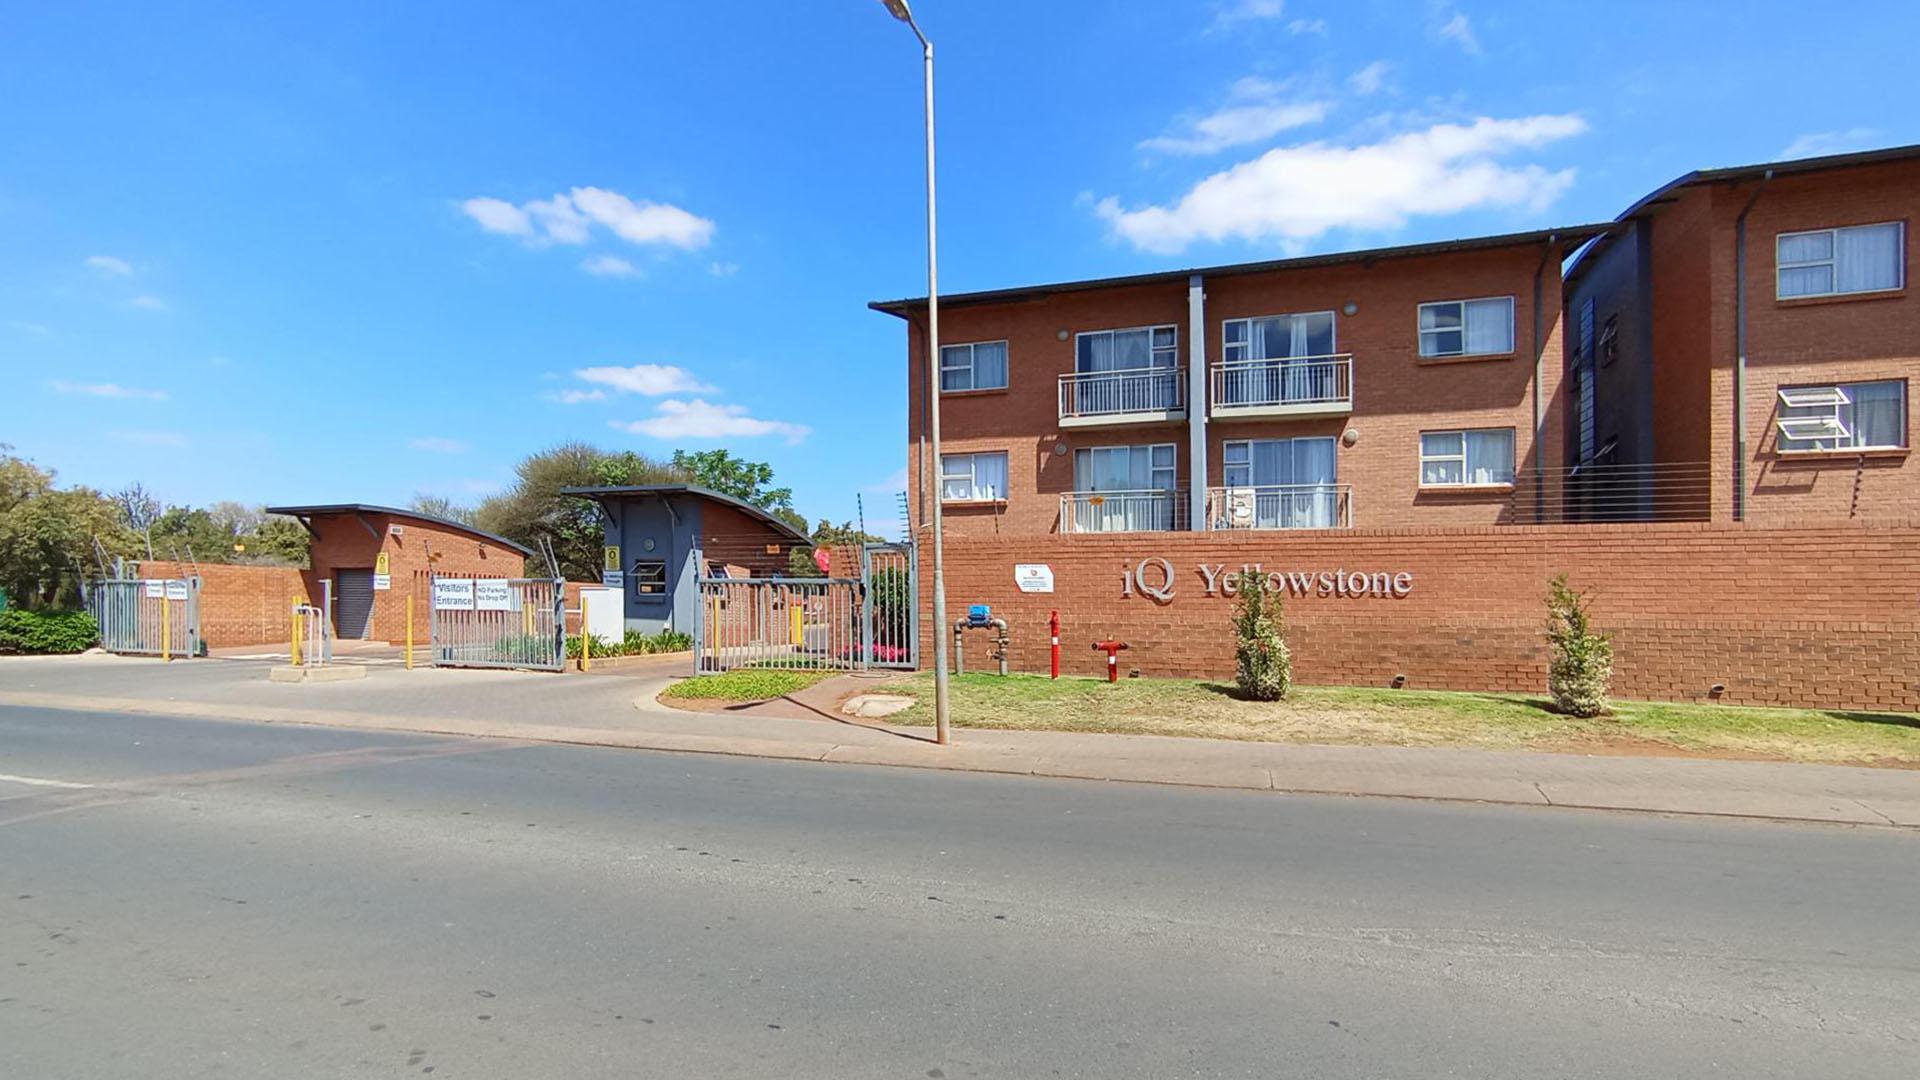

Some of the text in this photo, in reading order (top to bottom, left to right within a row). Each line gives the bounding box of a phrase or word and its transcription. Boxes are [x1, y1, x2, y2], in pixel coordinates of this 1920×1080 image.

[1122, 556, 1176, 600] iQ
[439, 583, 470, 593] Visitors
[437, 595, 473, 605] Entrance
